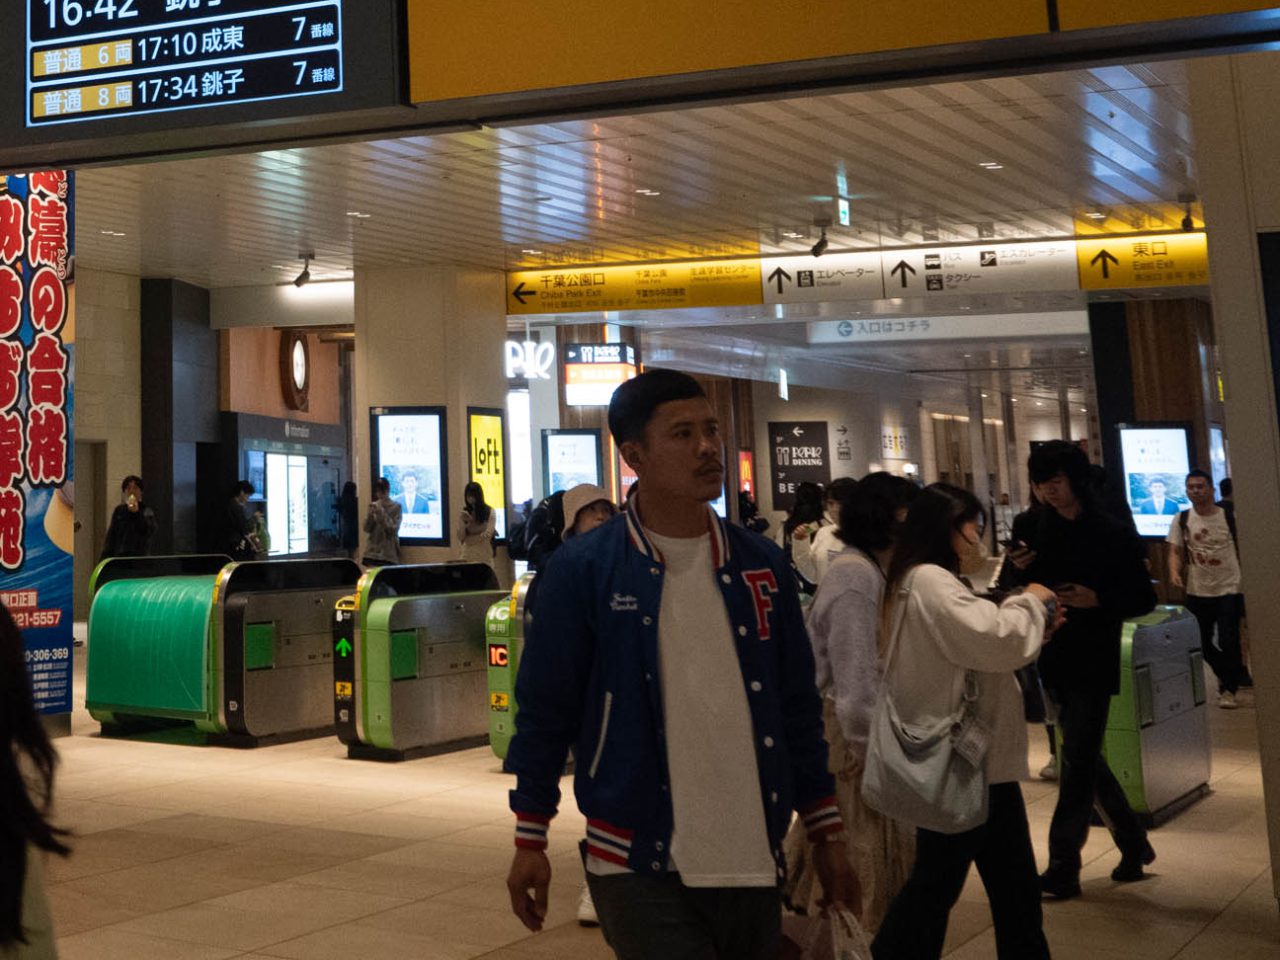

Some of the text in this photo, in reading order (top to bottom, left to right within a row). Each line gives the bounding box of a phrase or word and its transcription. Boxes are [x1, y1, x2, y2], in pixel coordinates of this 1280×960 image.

[44, 25, 244, 73] 普通 17:10 成東
[44, 69, 245, 115] 普通 17:34 銚子
[1133, 242, 1167, 257] 東口
[1133, 260, 1174, 271] East Exit
[540, 273, 605, 289] 千葉公園口
[817, 268, 875, 280] エレベーター
[946, 273, 981, 282] タクシー
[857, 320, 930, 334] 入口はコチラ
[792, 458, 822, 466] DINING
[742, 568, 778, 640] F
[489, 607, 509, 621] IC
[490, 646, 508, 665] IC
